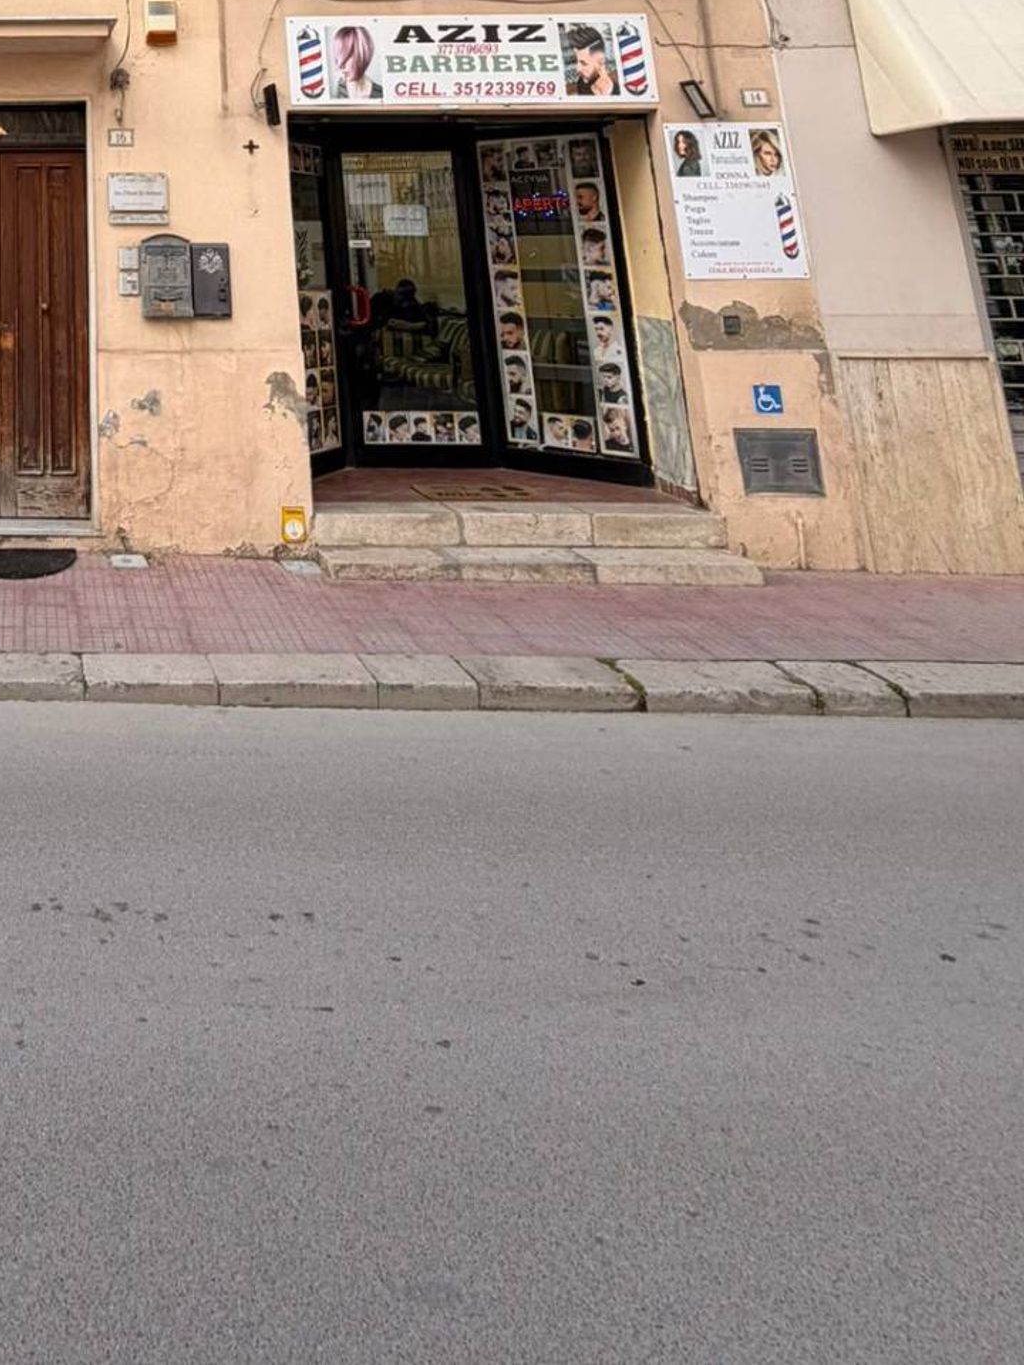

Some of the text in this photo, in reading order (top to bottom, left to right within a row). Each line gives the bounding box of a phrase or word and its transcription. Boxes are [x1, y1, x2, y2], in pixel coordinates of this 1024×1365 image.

[393, 24, 547, 43] AZIZ
[386, 54, 559, 73] BARBIERE
[394, 81, 557, 96] CELL. 3512339769
[714, 131, 742, 149] AZIZ
[716, 171, 750, 180] DONNA
